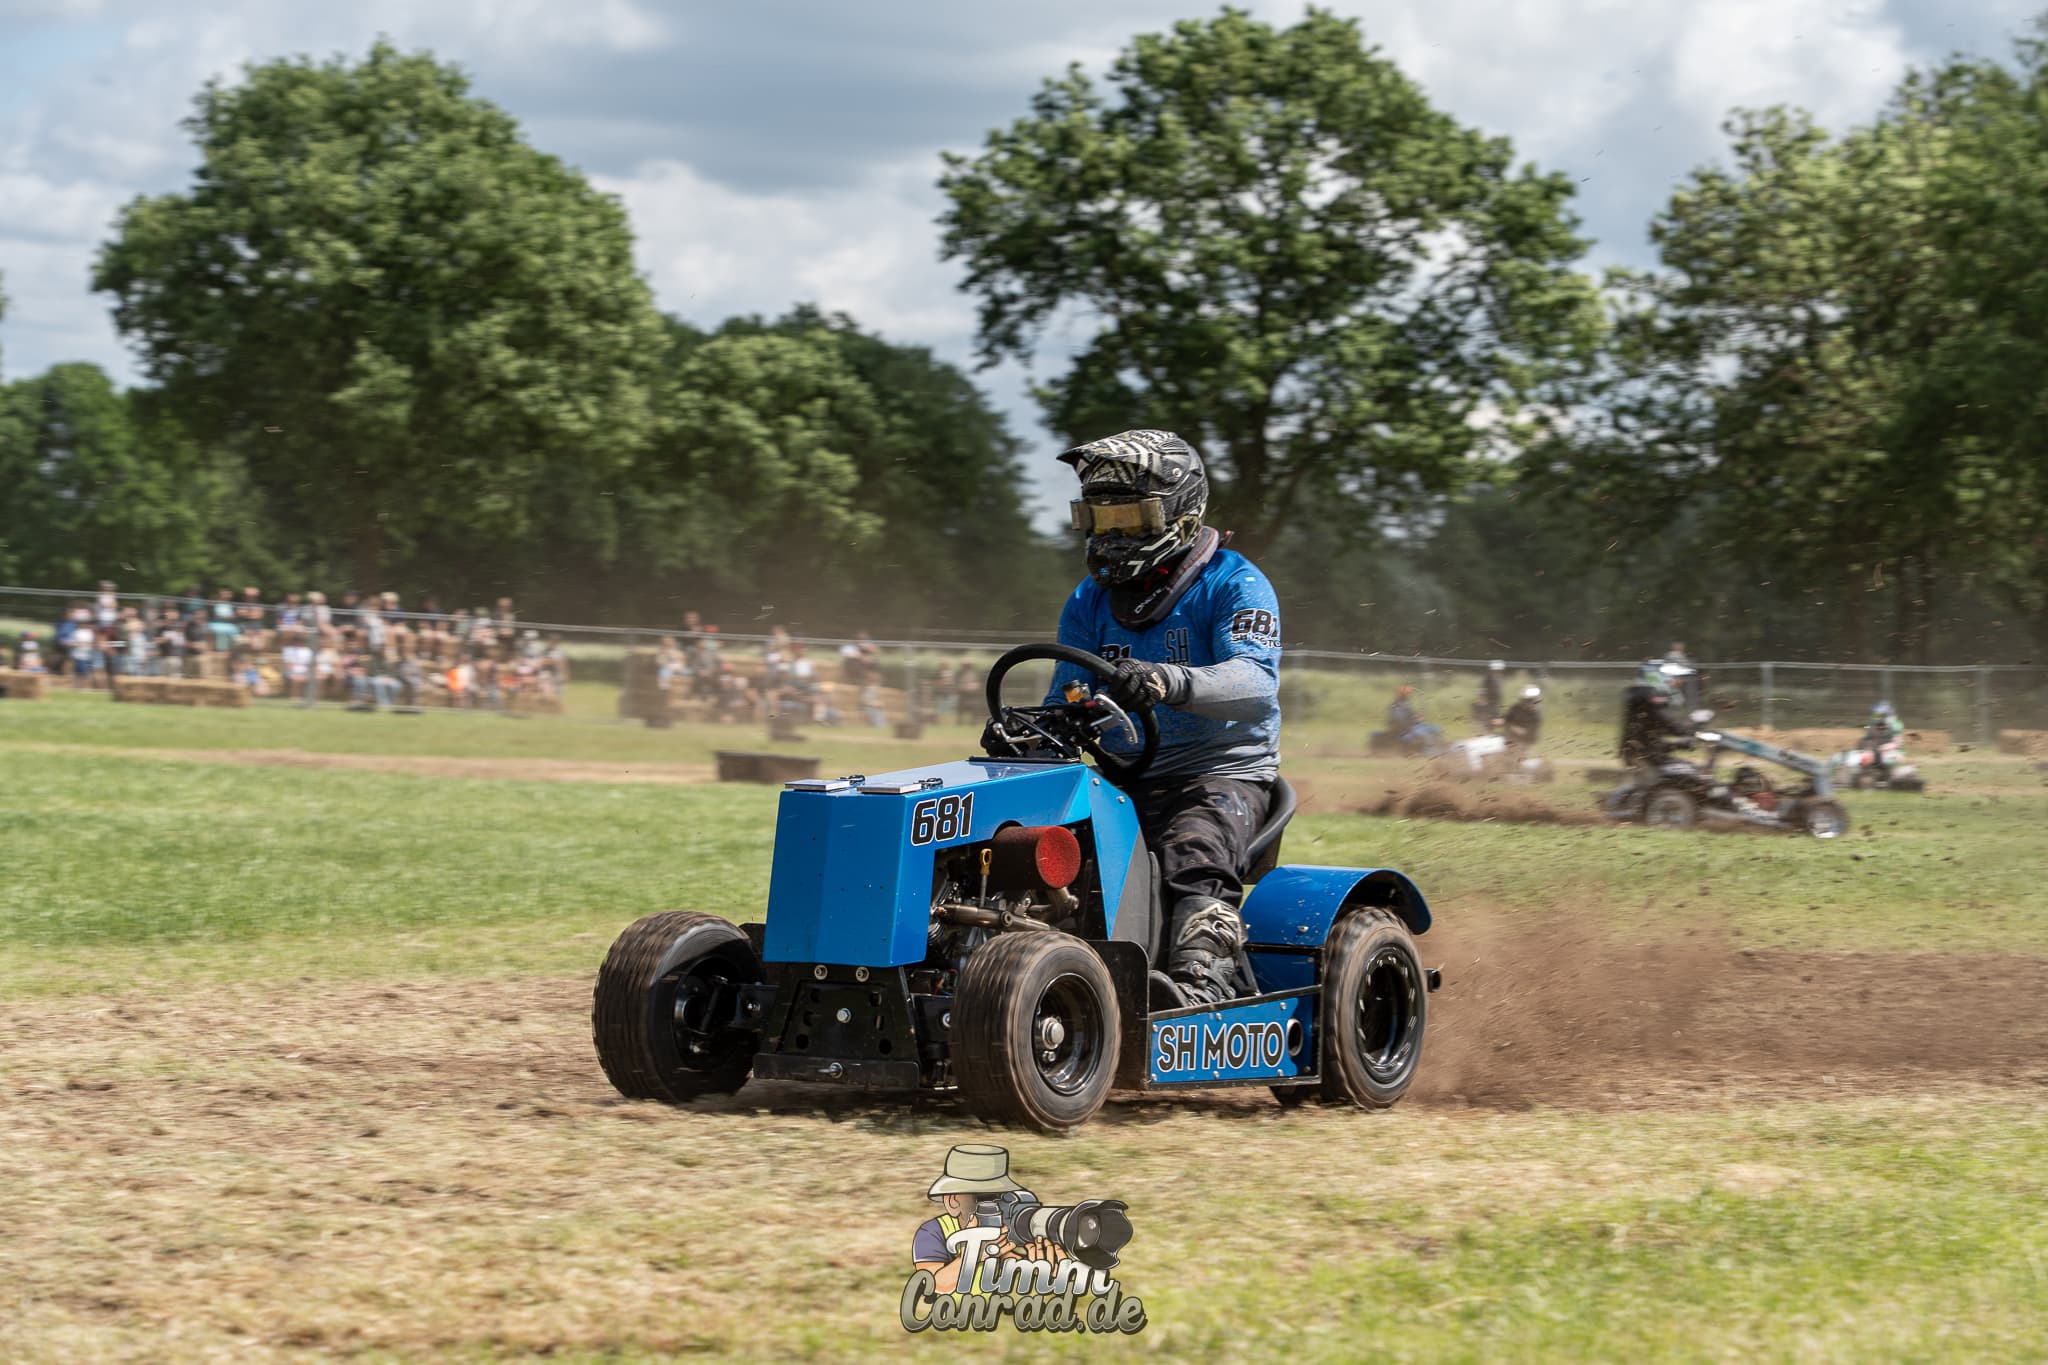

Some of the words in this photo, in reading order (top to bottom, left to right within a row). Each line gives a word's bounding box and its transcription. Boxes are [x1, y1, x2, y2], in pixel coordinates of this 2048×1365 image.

[1231, 608, 1279, 638] 681
[1164, 627, 1191, 665] SH
[911, 792, 974, 846] 681
[1157, 1025, 1197, 1072] SH
[1202, 1021, 1285, 1070] MOTO
